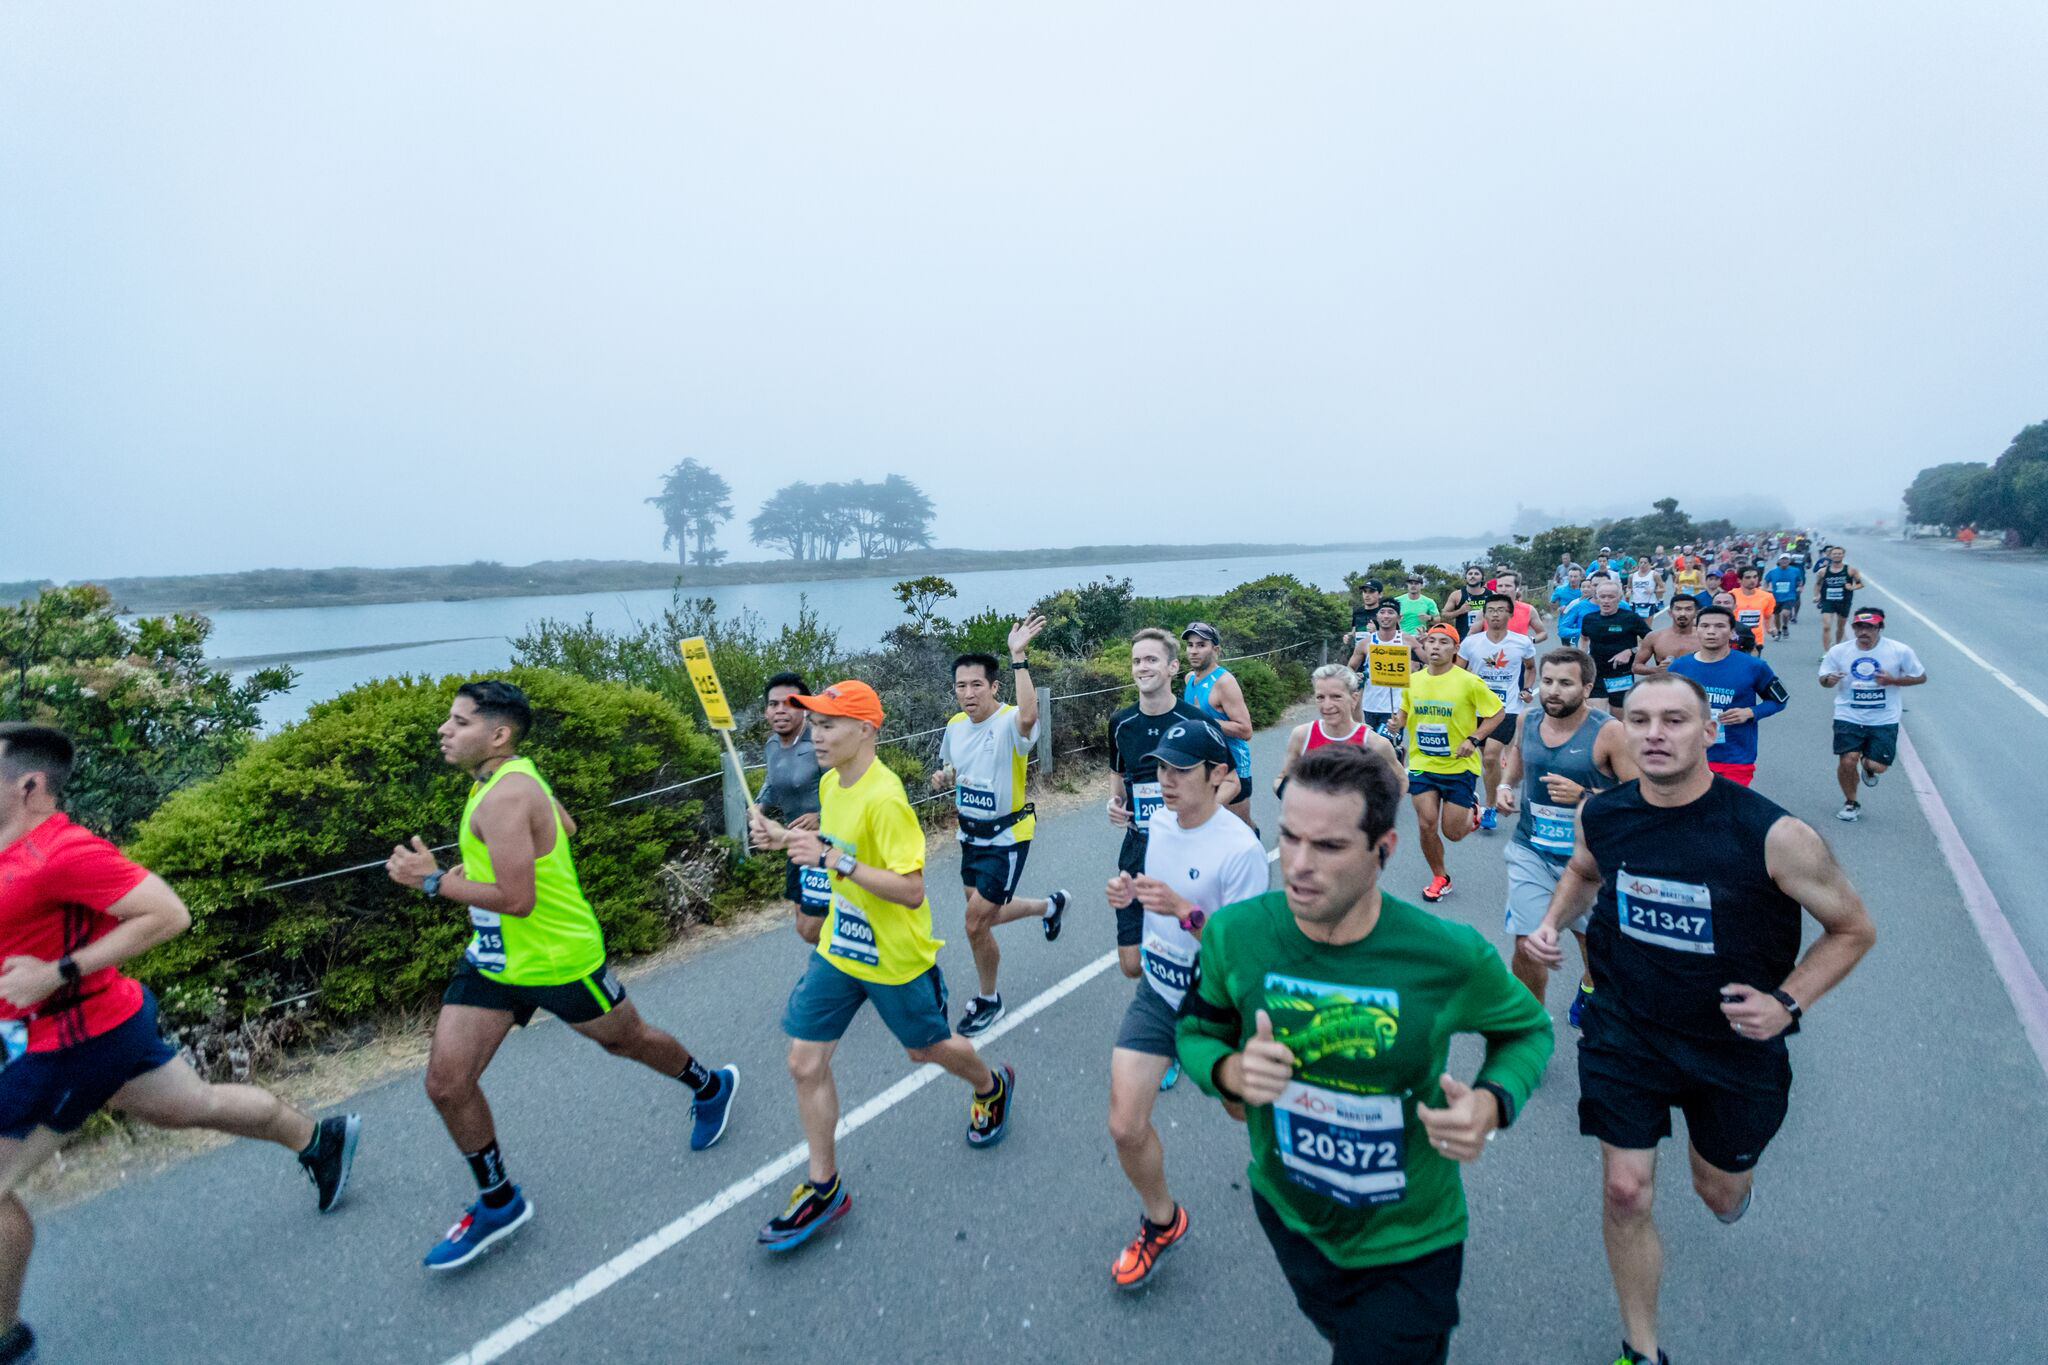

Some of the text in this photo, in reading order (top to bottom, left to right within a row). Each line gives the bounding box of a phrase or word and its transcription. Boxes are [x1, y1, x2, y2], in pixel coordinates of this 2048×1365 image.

[1374, 661, 1406, 672] 3:15
[1413, 705, 1453, 718] MARATHON
[1420, 735, 1447, 746] 20501
[962, 792, 993, 808] 20440
[1631, 905, 1707, 936] 21347
[1296, 1127, 1398, 1169] 20372
